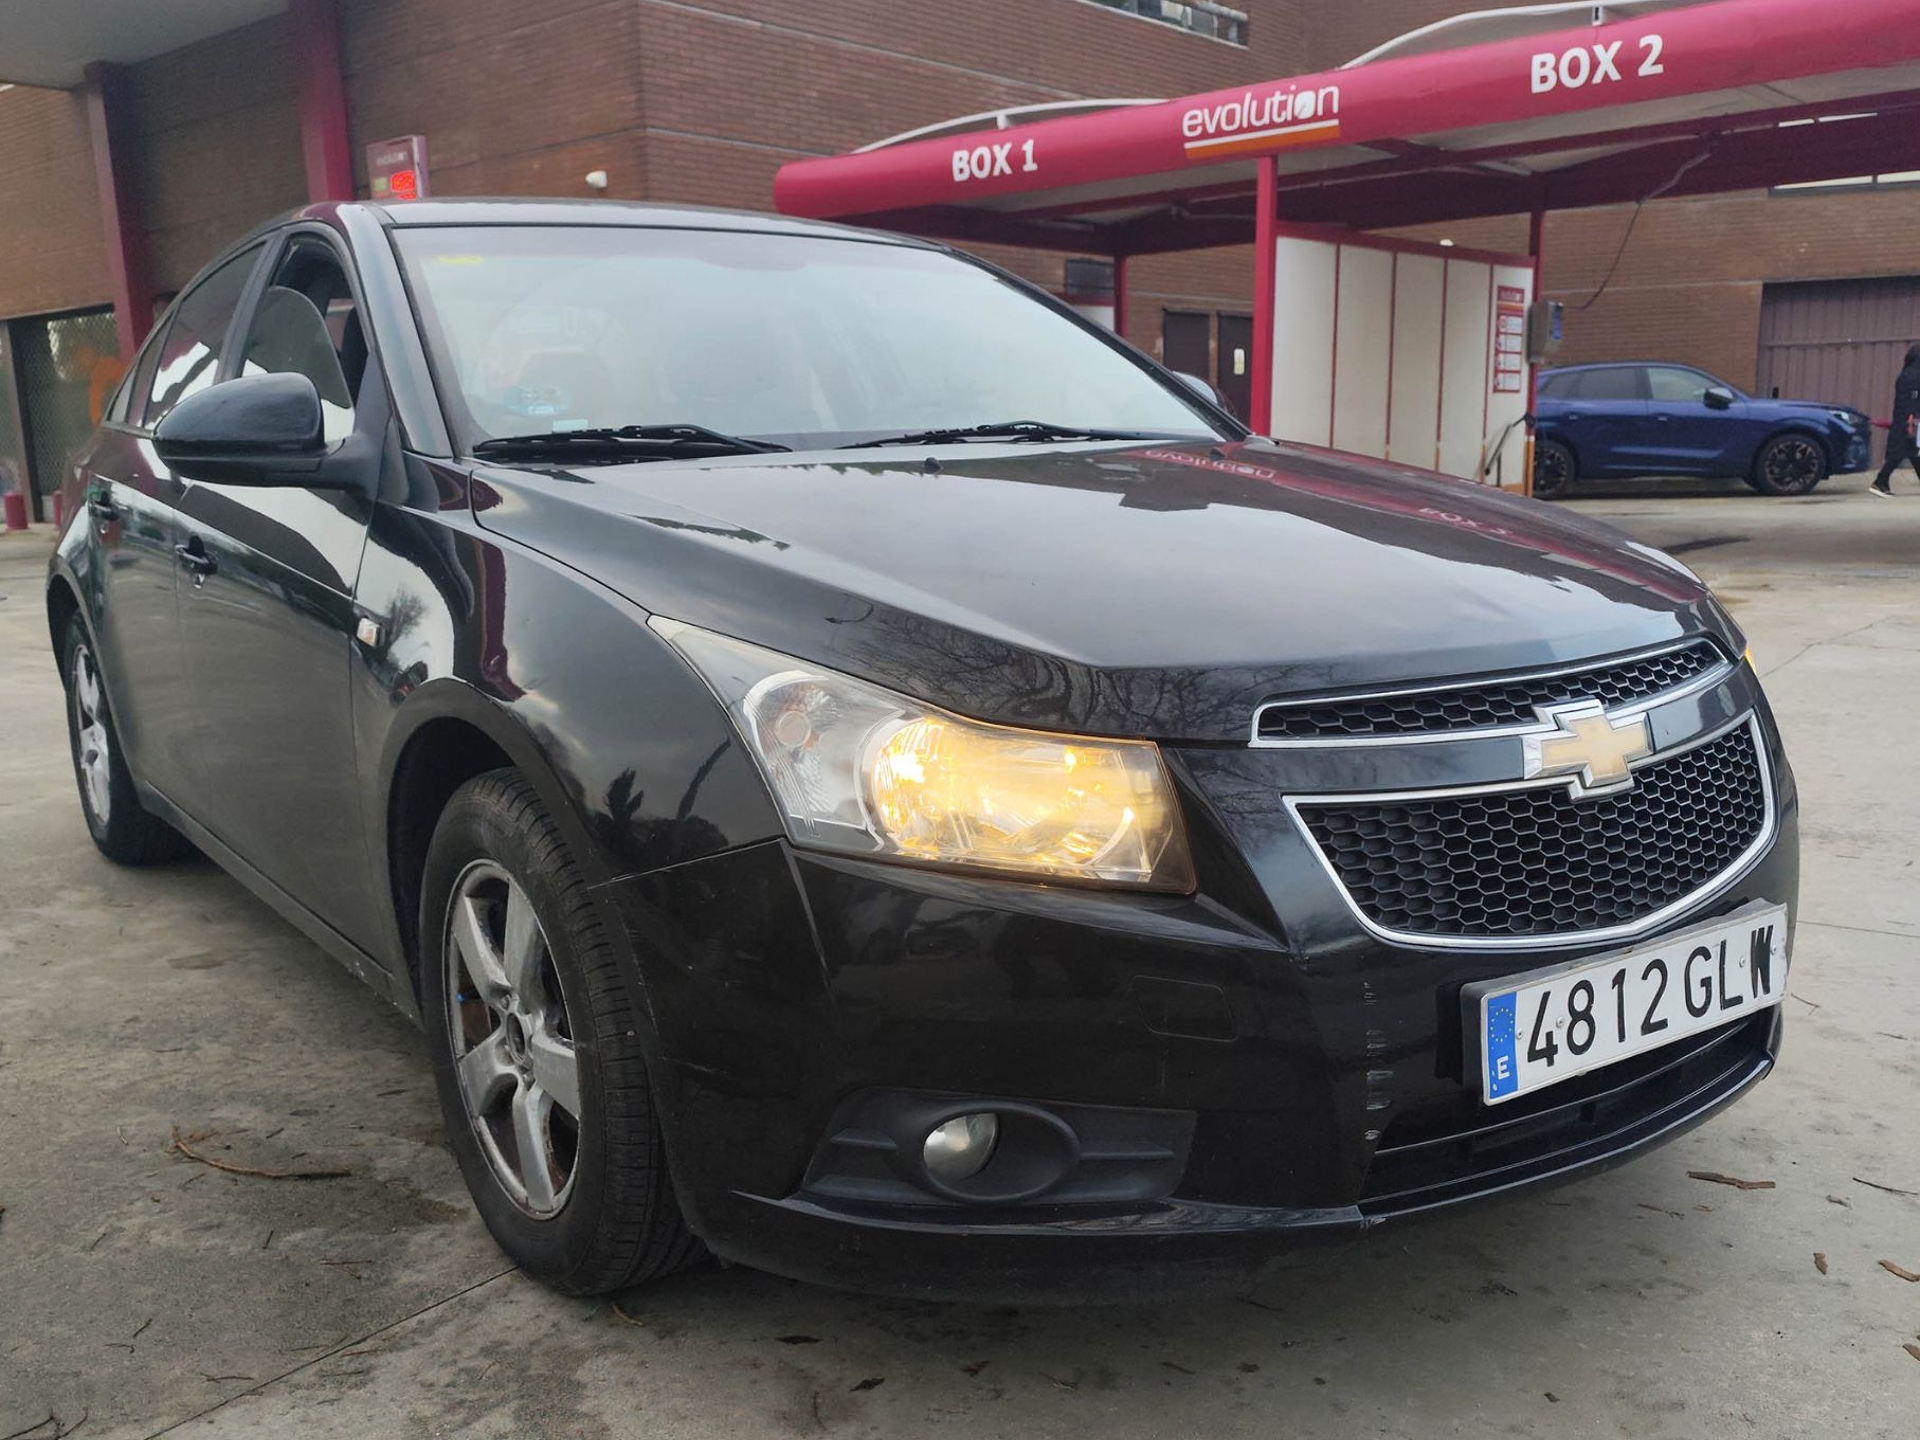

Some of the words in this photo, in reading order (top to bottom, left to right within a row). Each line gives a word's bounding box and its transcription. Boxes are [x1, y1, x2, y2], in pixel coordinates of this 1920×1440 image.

[1531, 41, 1622, 93] BOX
[1638, 34, 1664, 77] 2
[1182, 85, 1339, 137] evolution
[952, 144, 1012, 182] BOX
[1022, 139, 1038, 172] 1
[1527, 957, 1669, 1067] 4812
[1684, 925, 1773, 1018] GLW
[1496, 1056, 1509, 1079] E
